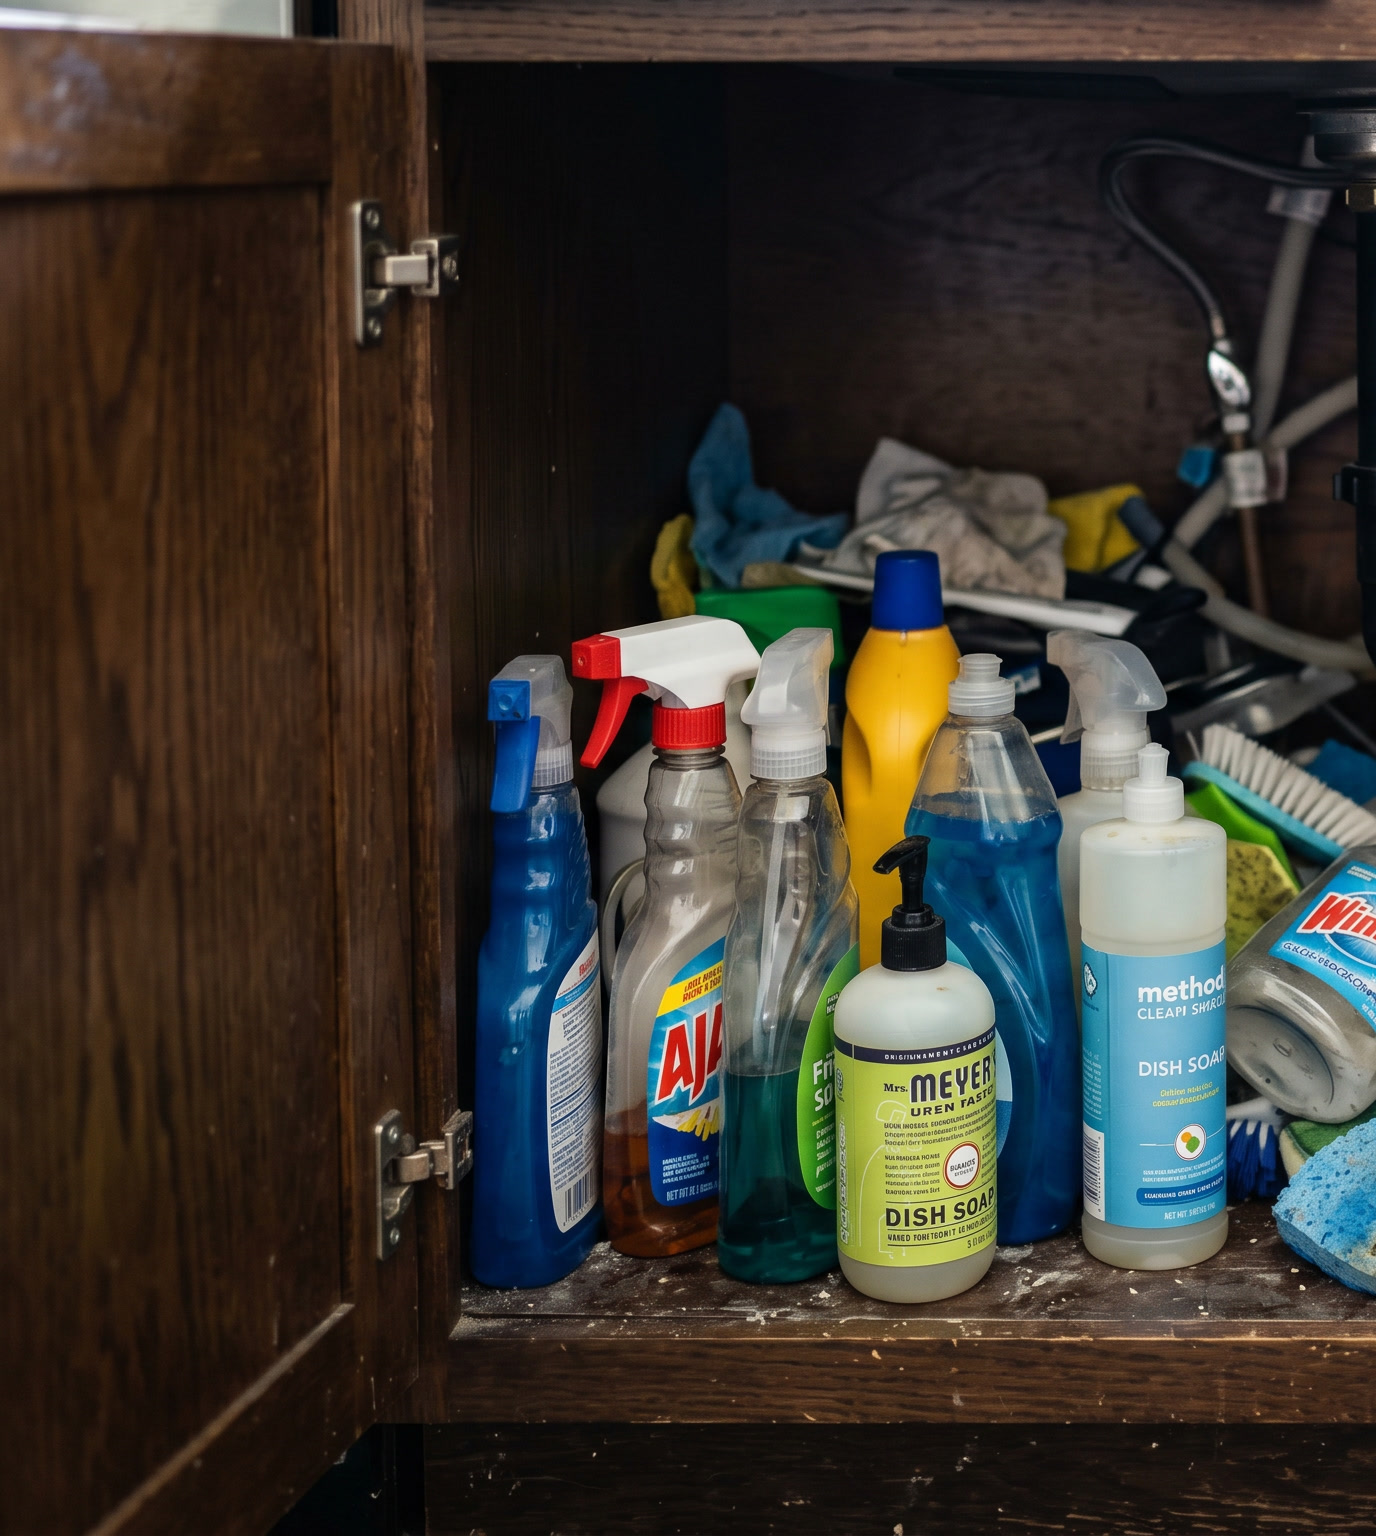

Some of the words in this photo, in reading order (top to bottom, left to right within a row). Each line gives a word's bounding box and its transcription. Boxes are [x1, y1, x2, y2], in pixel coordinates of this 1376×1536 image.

[1138, 965, 1225, 1003] method
[1138, 1060, 1182, 1077] DISH
[884, 1082, 908, 1093] Mrs.
[885, 1204, 946, 1228] DISH
[953, 1185, 995, 1221] SOAP
